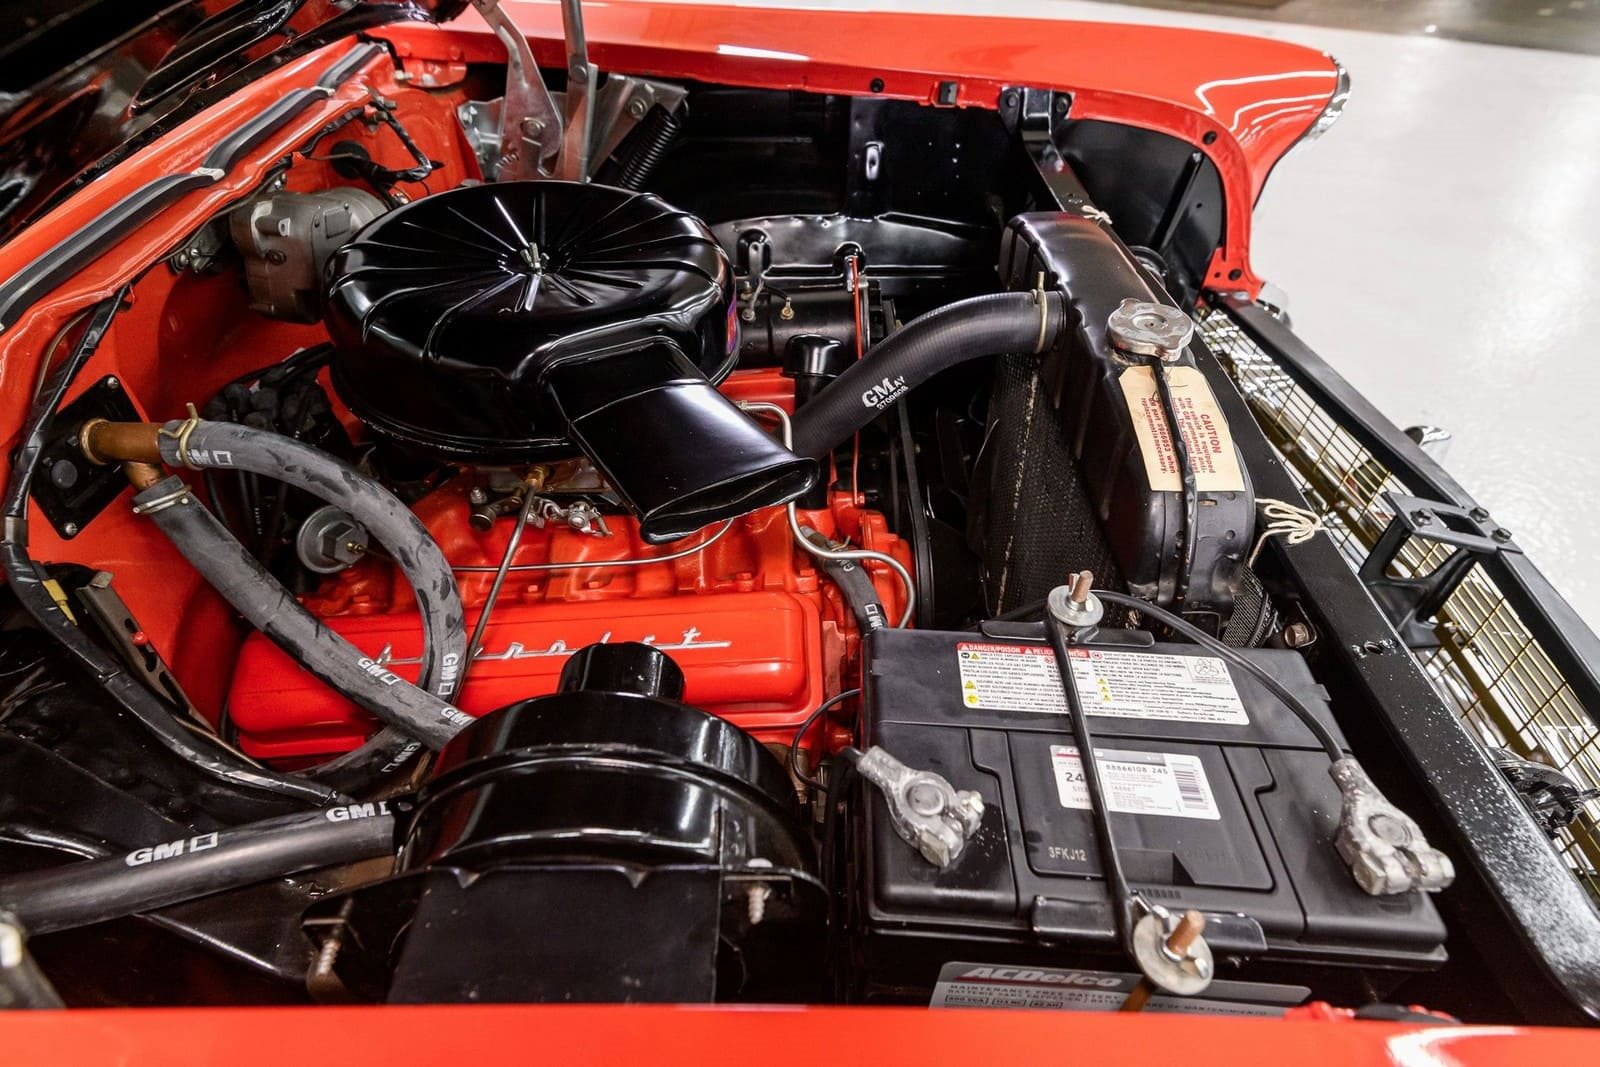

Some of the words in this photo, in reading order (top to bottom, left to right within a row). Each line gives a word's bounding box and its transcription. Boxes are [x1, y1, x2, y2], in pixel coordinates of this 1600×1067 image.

[1177, 397, 1186, 409] with
[1182, 410, 1191, 420] GM
[1141, 397, 1157, 433] replacement
[1153, 438, 1168, 474] necessary.
[1151, 408, 1161, 421] part
[1166, 455, 1176, 474] when
[1185, 421, 1203, 455] permanent
[1190, 410, 1202, 431] vehicle
[1201, 440, 1216, 474] equipped
[1200, 414, 1222, 454] CAUTION
[1198, 456, 1207, 474] anti-
[357, 657, 388, 677] GM
[441, 652, 459, 680] GM
[326, 800, 375, 822] GM
[125, 839, 184, 867] GM
[1048, 846, 1087, 862] 3FKJ12
[960, 967, 1122, 987] ACDelco
[950, 984, 1030, 994] MAINTENANCE
[1067, 992, 1120, 1000] BATTERY
